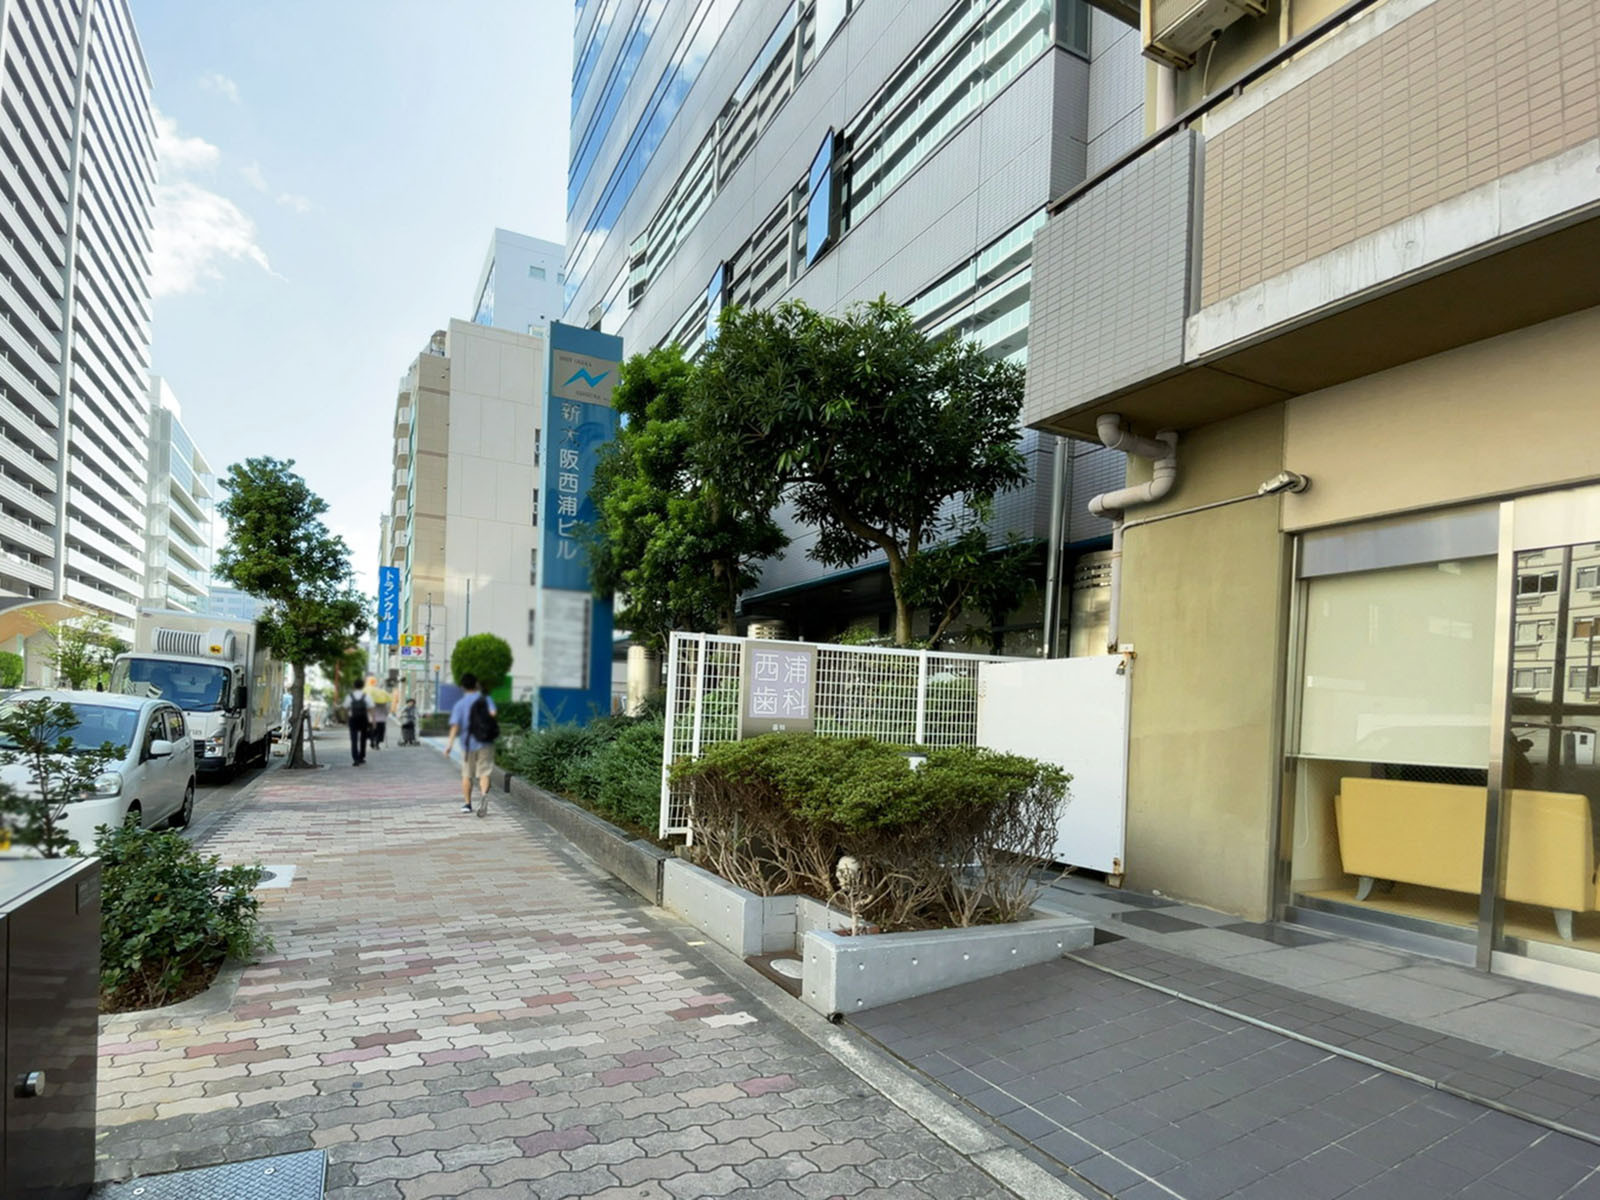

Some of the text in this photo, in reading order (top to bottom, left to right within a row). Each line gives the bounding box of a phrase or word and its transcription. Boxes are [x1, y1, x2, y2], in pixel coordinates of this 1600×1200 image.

[383, 570, 395, 640] トランクルーム
[755, 653, 808, 684] 西浦
[752, 686, 806, 716] 歯科
